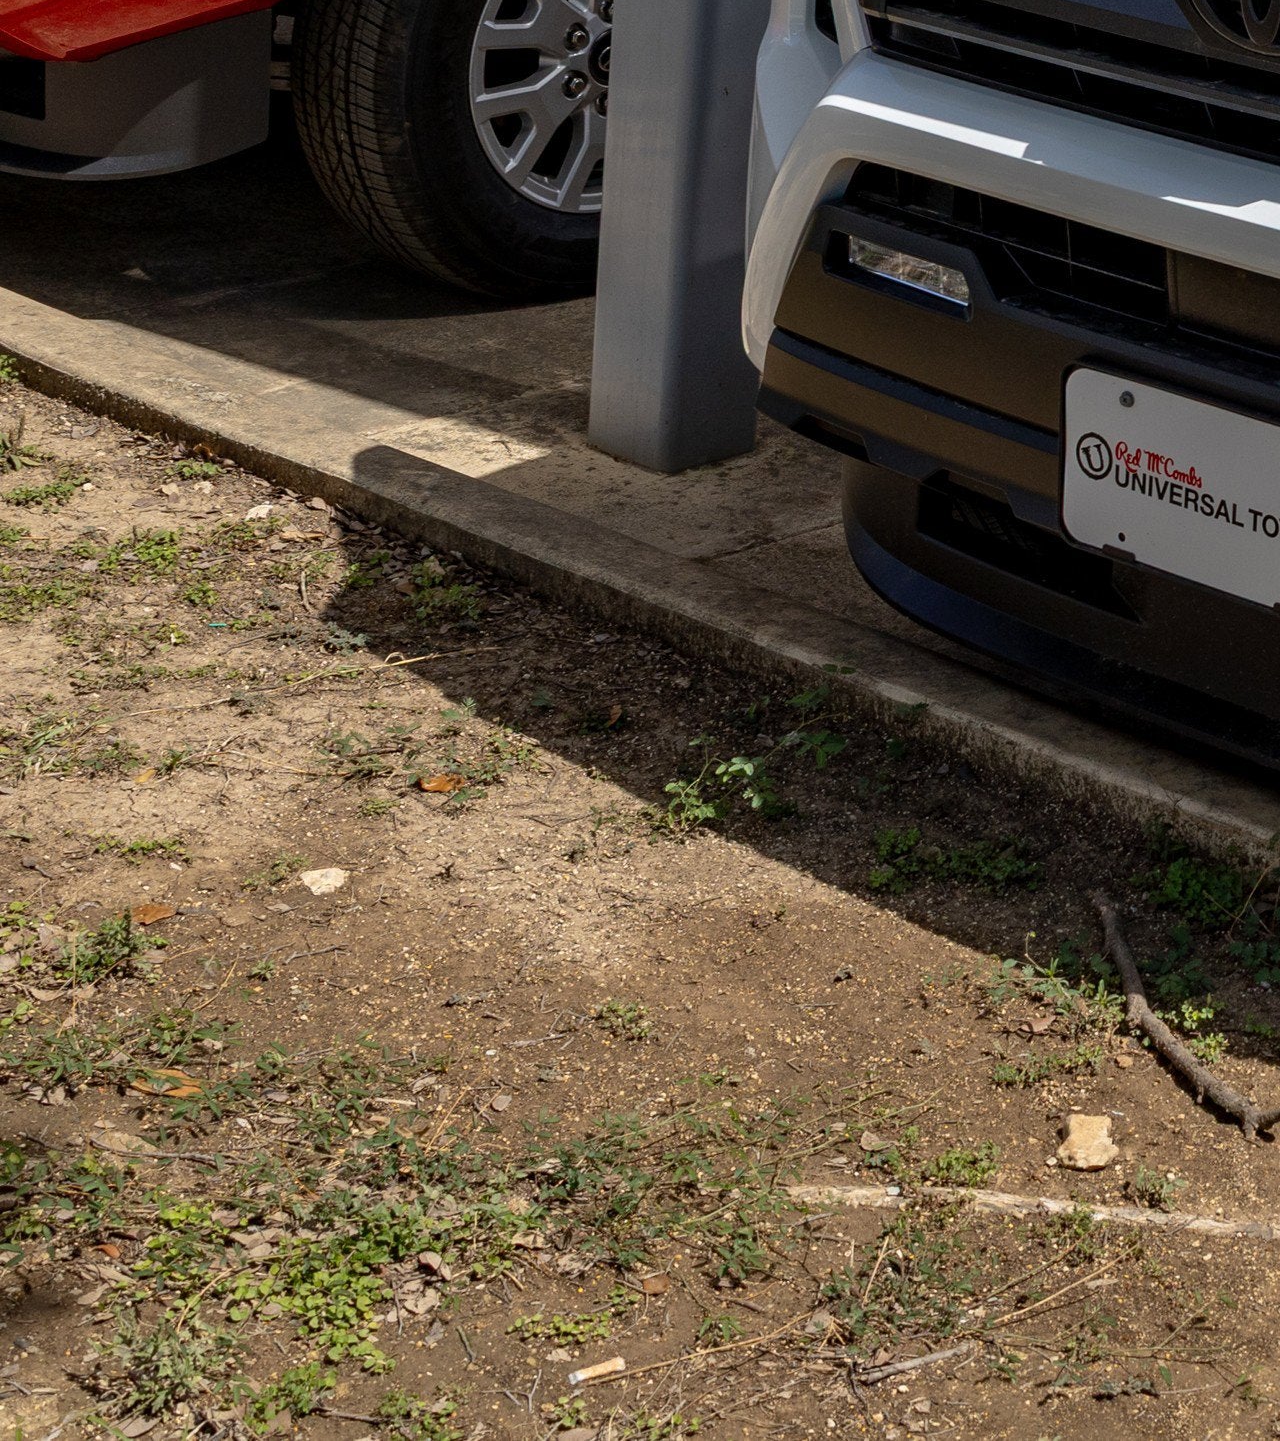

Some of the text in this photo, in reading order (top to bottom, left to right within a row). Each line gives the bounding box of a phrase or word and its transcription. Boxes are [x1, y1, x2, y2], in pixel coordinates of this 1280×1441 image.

[1081, 444, 1103, 473] U
[1115, 441, 1203, 489] Red McCombs
[1115, 464, 1244, 528] UNIVERSAL
